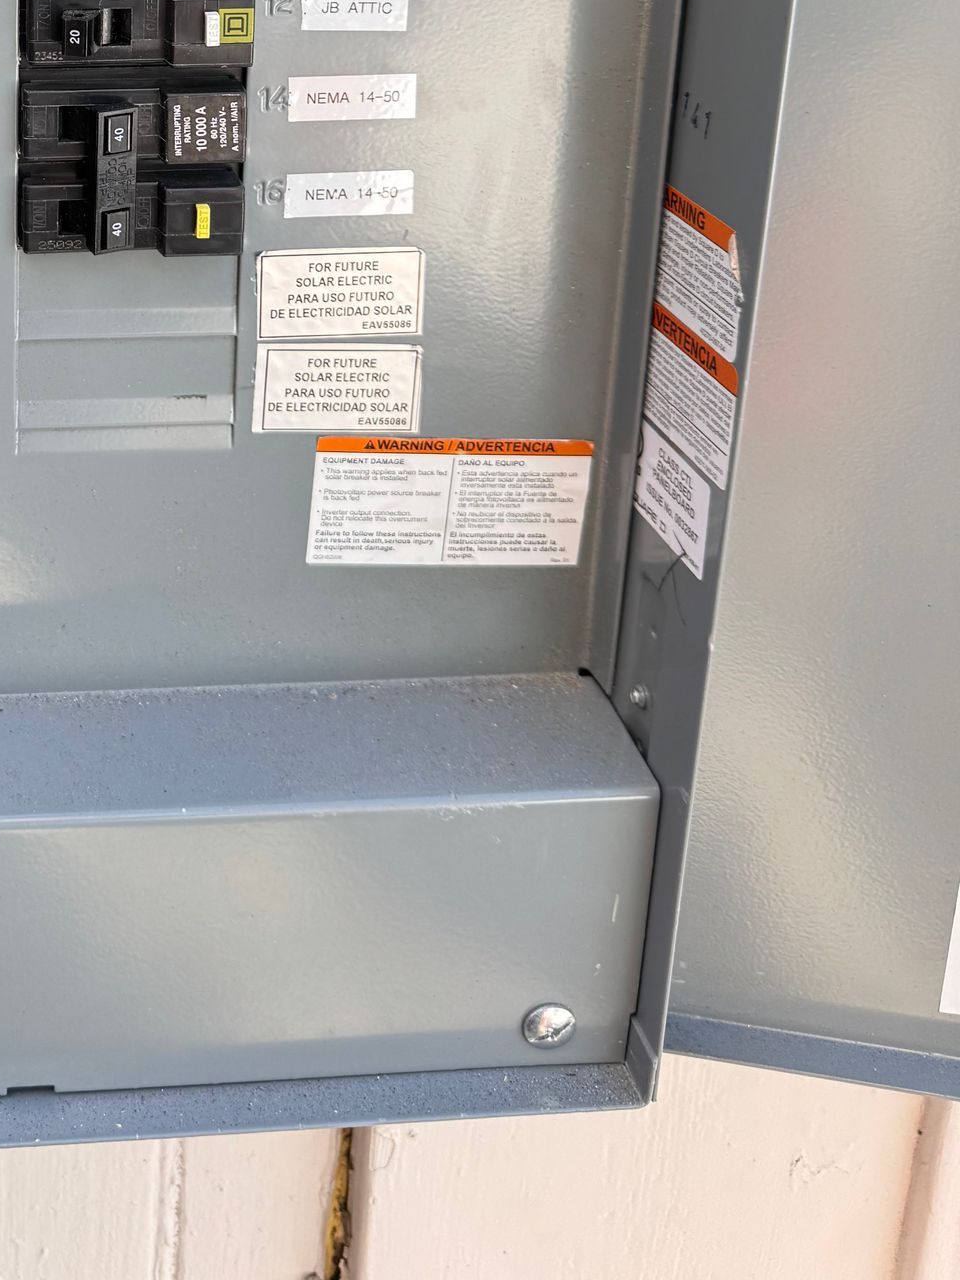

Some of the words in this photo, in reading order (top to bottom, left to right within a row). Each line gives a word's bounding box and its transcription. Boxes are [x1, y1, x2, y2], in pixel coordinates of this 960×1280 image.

[322, 2, 339, 13] JB
[348, 2, 392, 14] ATTIC
[208, 13, 219, 45] TEST
[70, 29, 80, 44] 20
[258, 86, 289, 112] 14
[306, 92, 349, 104] NEMA
[360, 91, 400, 103] 14-50
[196, 106, 206, 116] A
[196, 118, 207, 137] 000
[211, 118, 217, 128] Hz
[114, 127, 124, 142] 40
[211, 130, 217, 140] 60
[198, 138, 207, 152] 10
[253, 180, 285, 206] 16
[305, 189, 348, 200] NEMA
[358, 187, 398, 199] 14-50
[664, 188, 706, 230] ARNING
[198, 206, 208, 238] TEST
[112, 223, 122, 237] 40
[309, 263, 332, 272] FOR
[335, 261, 379, 271] FUTURE
[296, 277, 334, 287] SOLAR
[338, 275, 392, 286] ELECTRIC
[288, 294, 318, 304] PARA
[322, 293, 345, 302] USO
[349, 292, 394, 301] FUTURO
[270, 310, 285, 319] DE
[289, 307, 370, 318] ELECTRICIDAD
[374, 305, 412, 315] SOLAR
[362, 320, 411, 329] EAV55086
[654, 308, 717, 376] VERTENCIA
[308, 359, 330, 368] FOR
[334, 359, 377, 367] FUTURE
[294, 372, 332, 382] SOLAR
[336, 372, 390, 382] ELECTRIC
[285, 388, 315, 397] PARA
[319, 388, 341, 397] USO
[345, 388, 390, 398] FUTURO
[268, 402, 282, 412] DE
[287, 402, 366, 412] ELECTRICIDAD
[371, 403, 408, 412] SOLAR
[378, 440, 444, 450] WARNING
[448, 441, 453, 450] /
[456, 441, 555, 452] ADVERTENCIA
